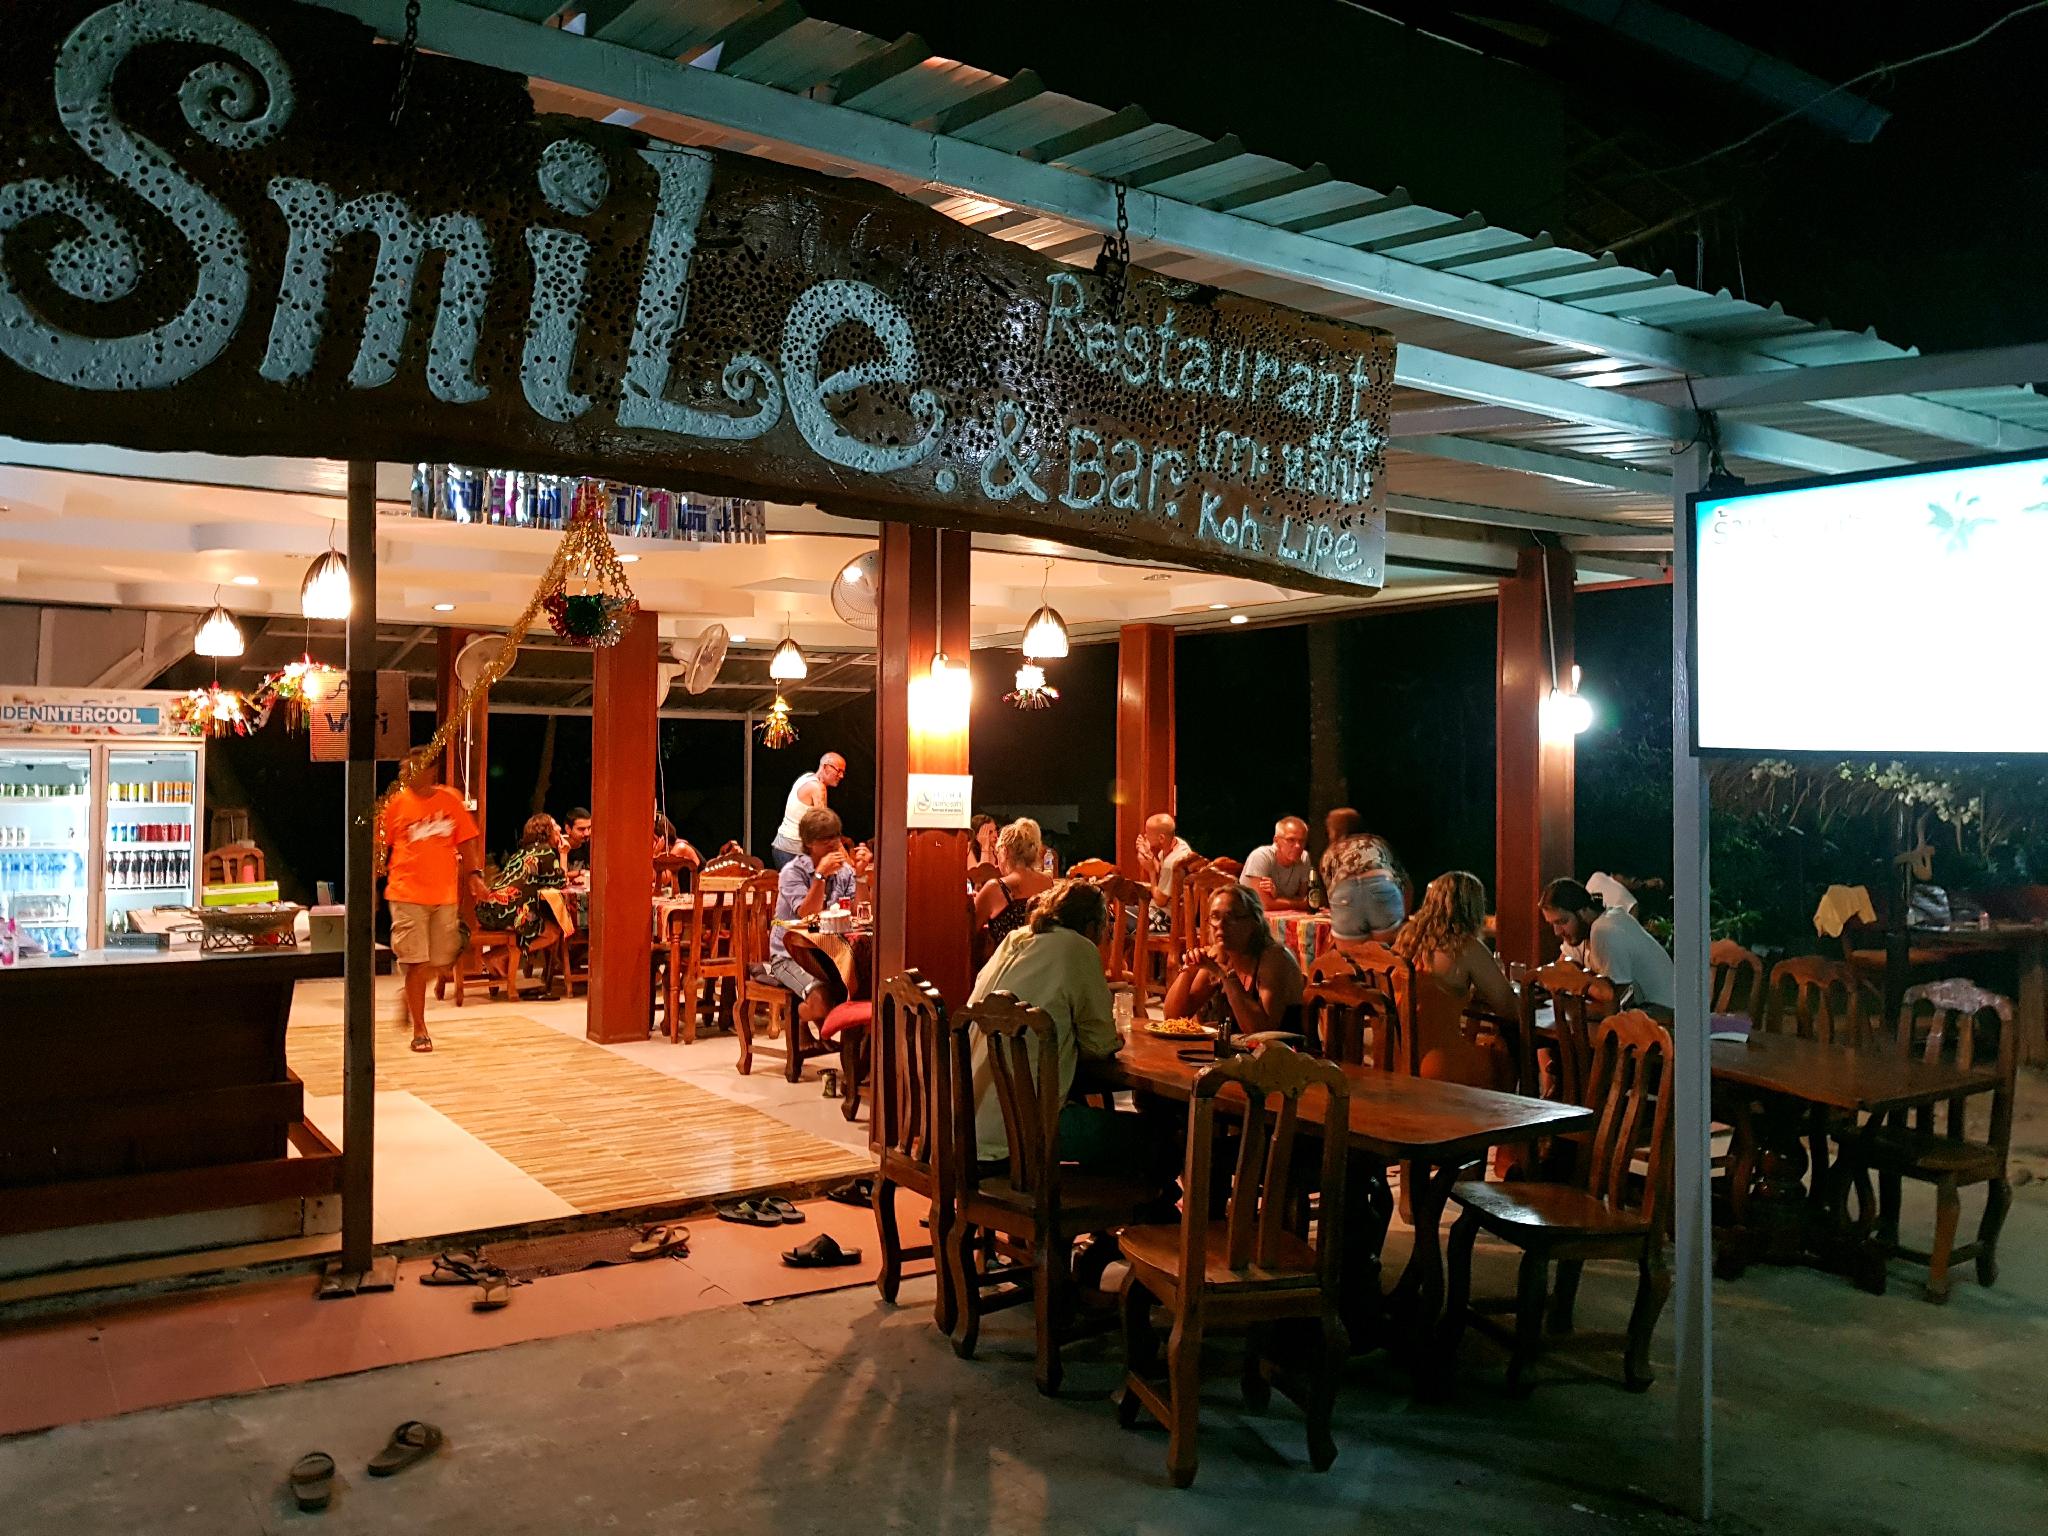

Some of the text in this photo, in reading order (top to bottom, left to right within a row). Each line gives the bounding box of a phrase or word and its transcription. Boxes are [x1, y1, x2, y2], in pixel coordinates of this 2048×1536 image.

[1043, 272, 1370, 421] Restaurant
[980, 399, 1049, 503] &
[1199, 491, 1264, 552] Koh
[0, 705, 142, 723] DEN INTERCOOL
